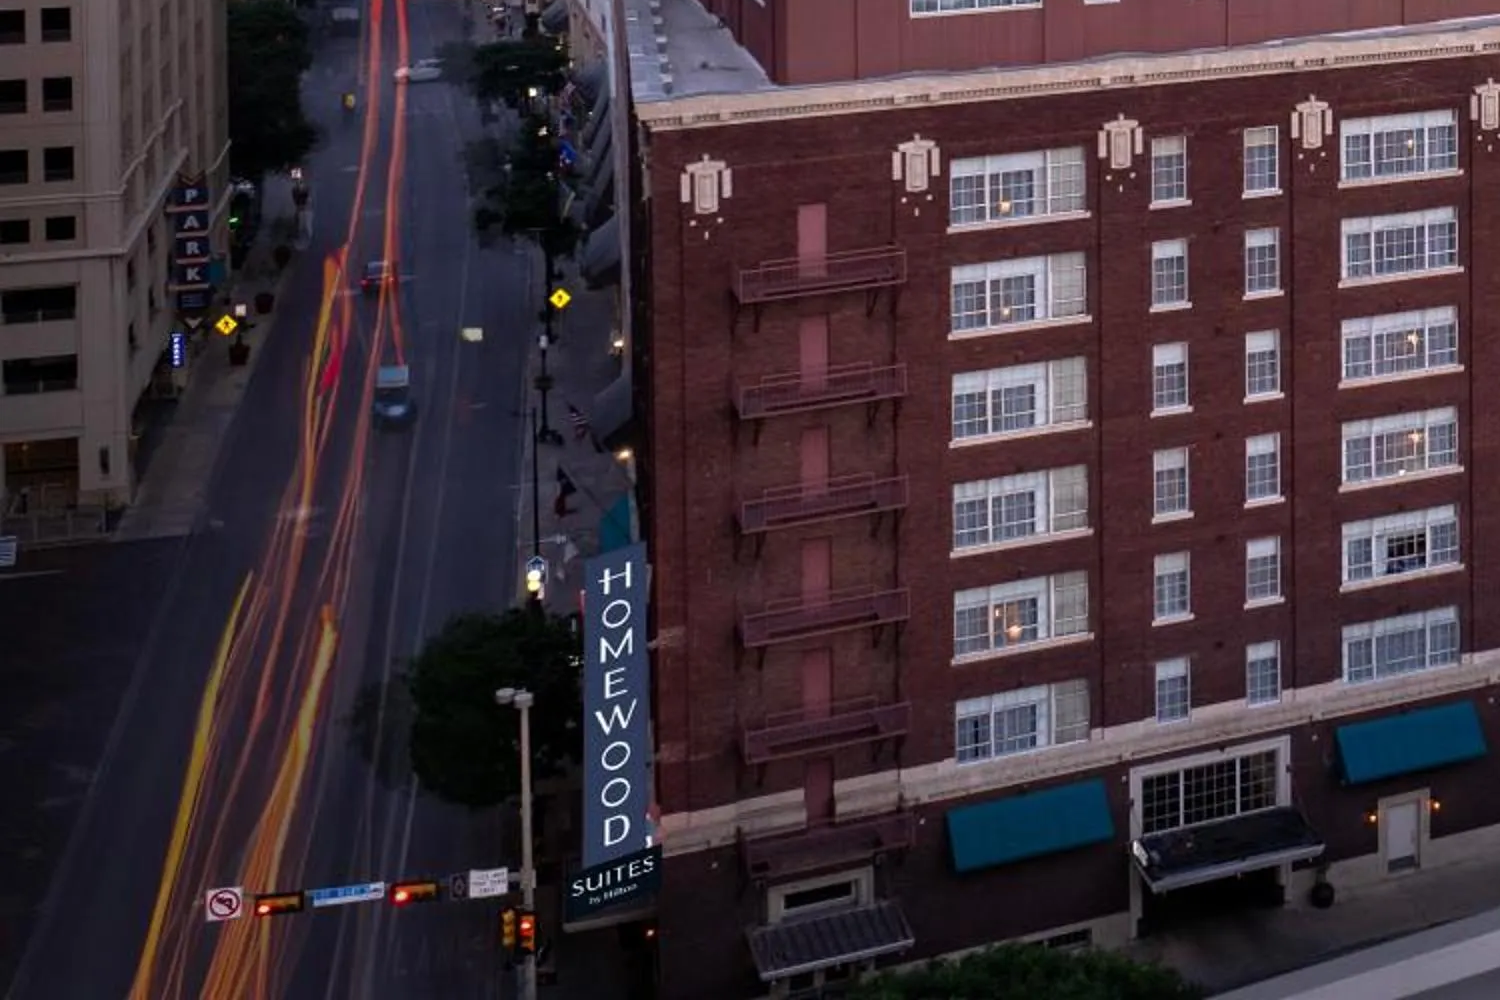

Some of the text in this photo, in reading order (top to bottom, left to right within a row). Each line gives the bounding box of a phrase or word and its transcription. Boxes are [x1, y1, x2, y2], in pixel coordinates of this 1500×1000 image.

[184, 188, 202, 281] PARK
[594, 560, 638, 847] HOMEWOOD
[571, 855, 655, 898] SUITES
